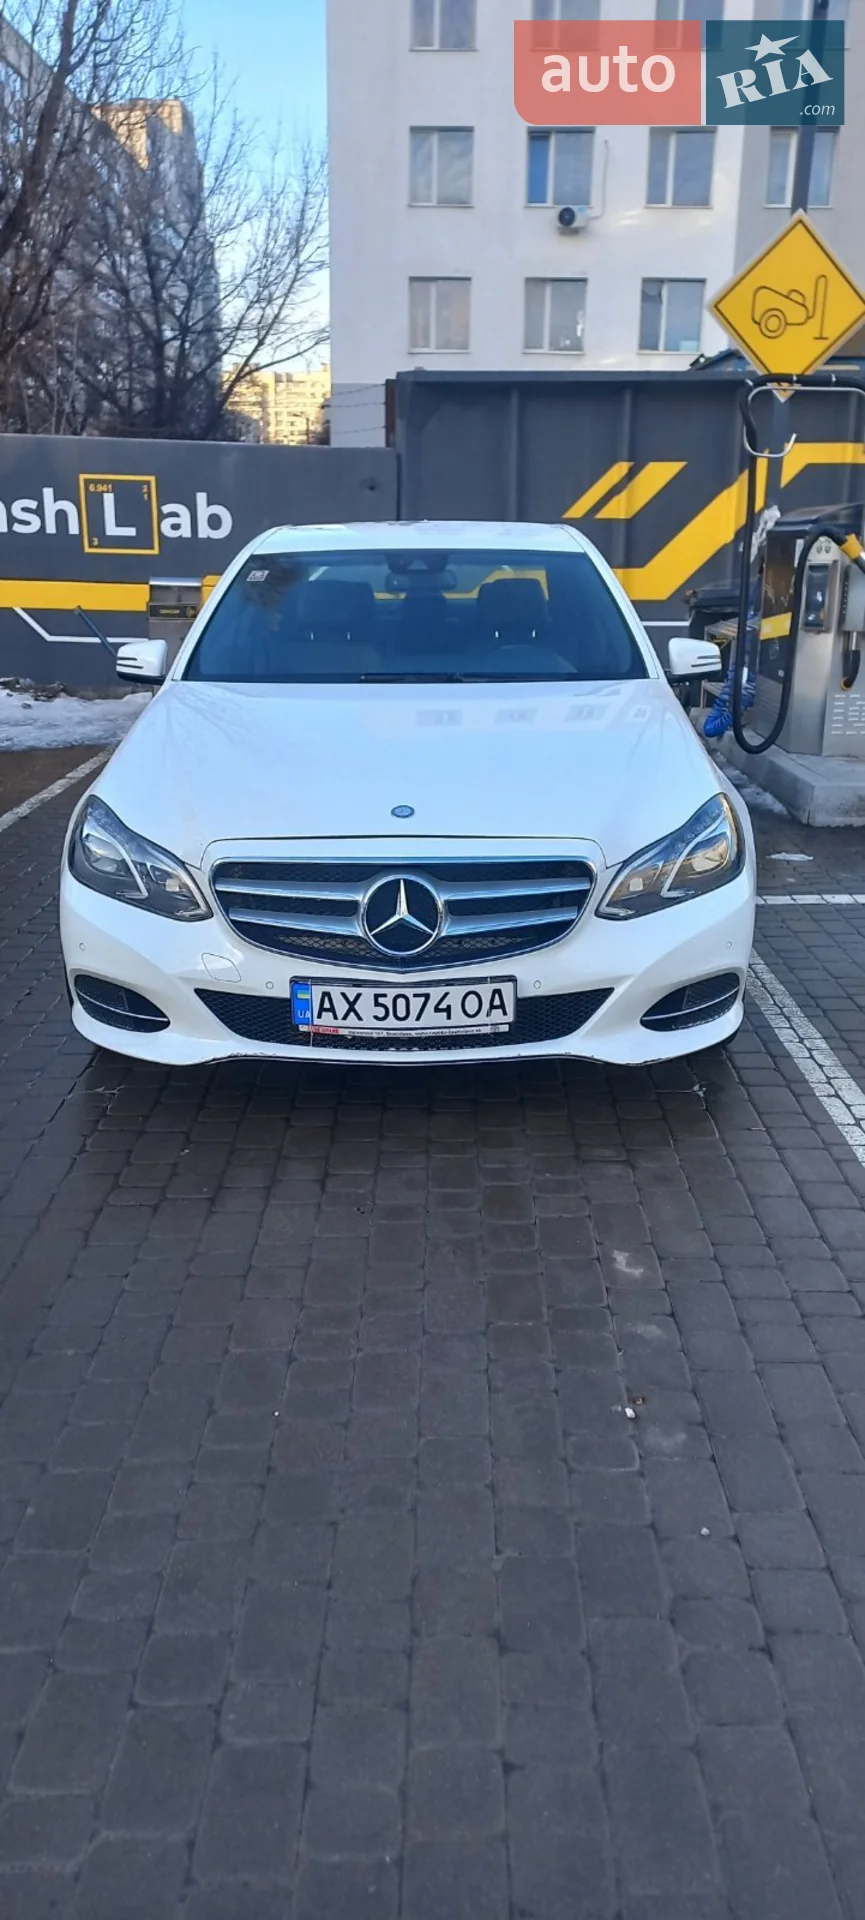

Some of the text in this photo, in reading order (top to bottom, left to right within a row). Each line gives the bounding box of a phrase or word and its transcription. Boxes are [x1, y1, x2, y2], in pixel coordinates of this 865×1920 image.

[88, 483, 113, 493] 6.941
[0, 487, 80, 535] sh
[92, 537, 99, 546] 3
[316, 988, 508, 1023] AX 5074 OA
[298, 1010, 311, 1019] UA
